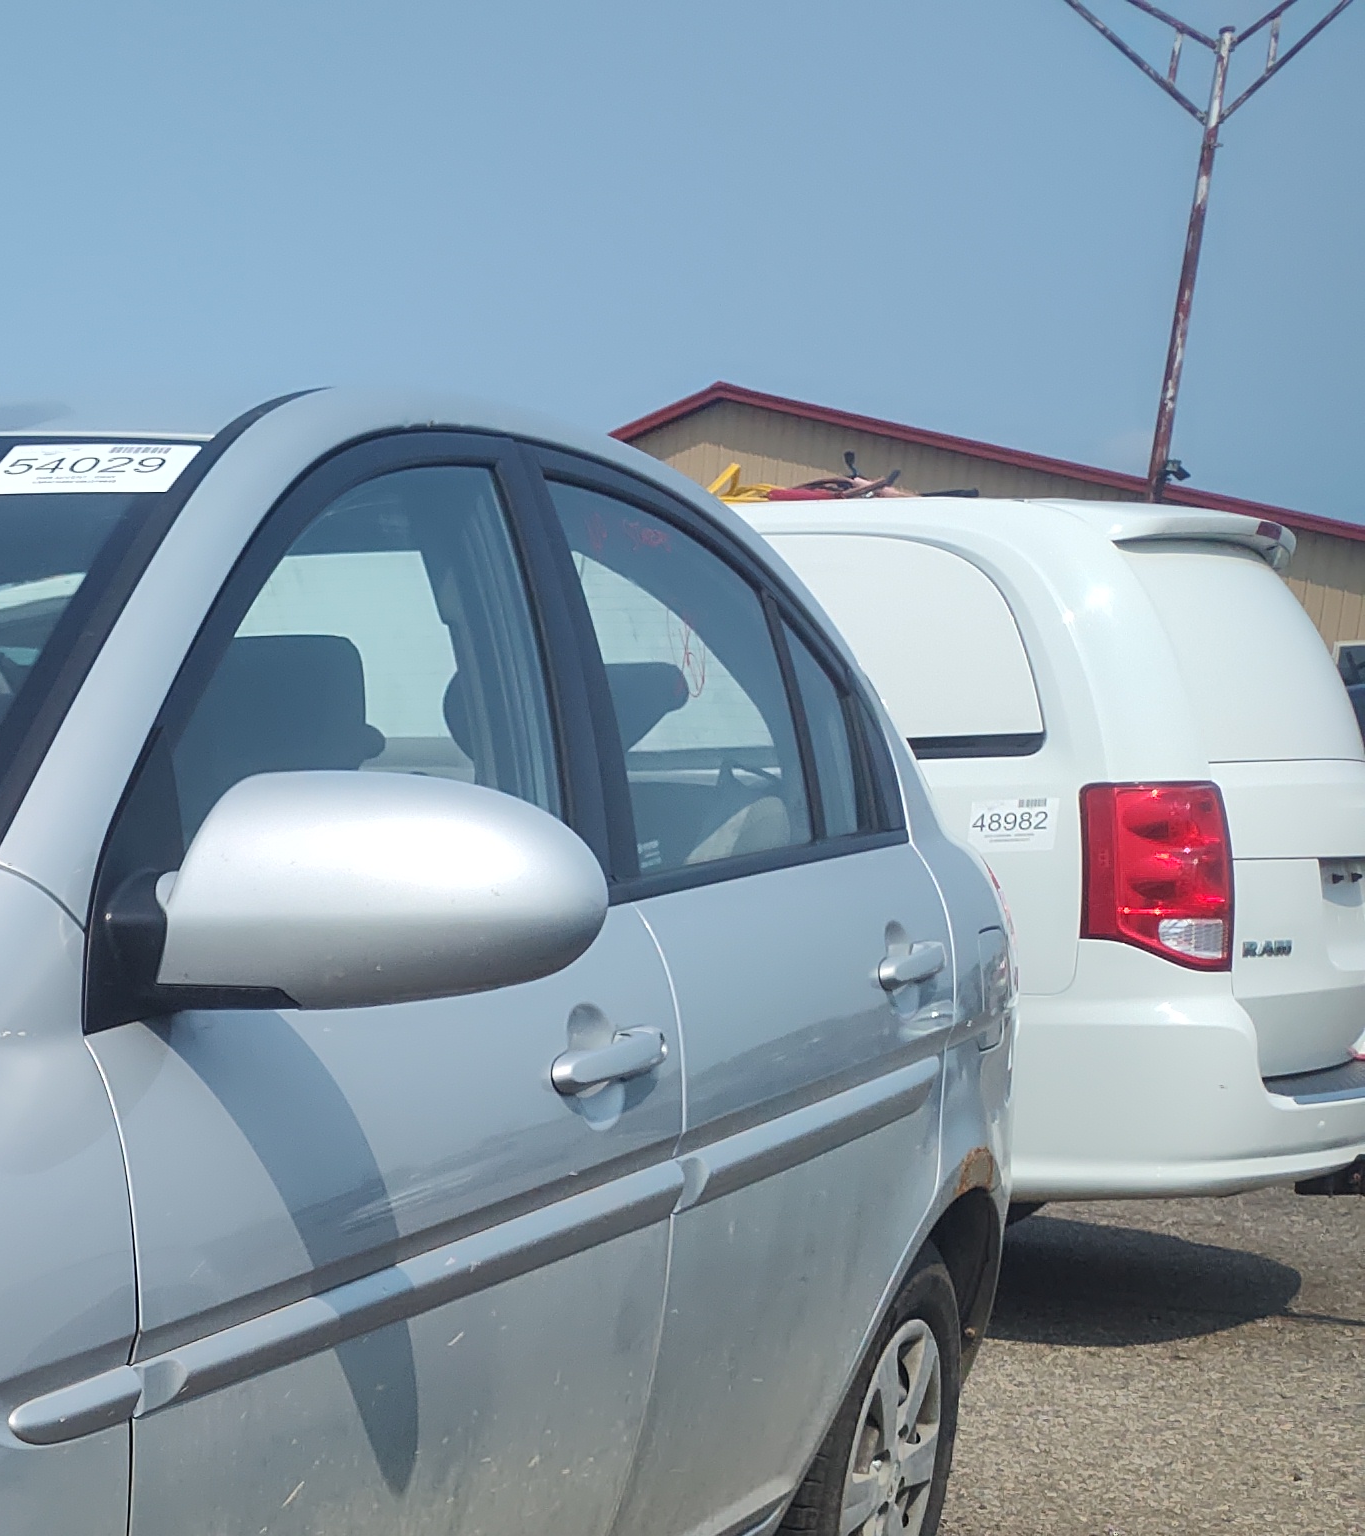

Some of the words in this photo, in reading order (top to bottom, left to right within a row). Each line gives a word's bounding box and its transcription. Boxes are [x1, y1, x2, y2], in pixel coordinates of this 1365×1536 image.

[4, 457, 167, 475] 54029
[972, 811, 1048, 832] 48982
[1242, 940, 1292, 958] RAM
